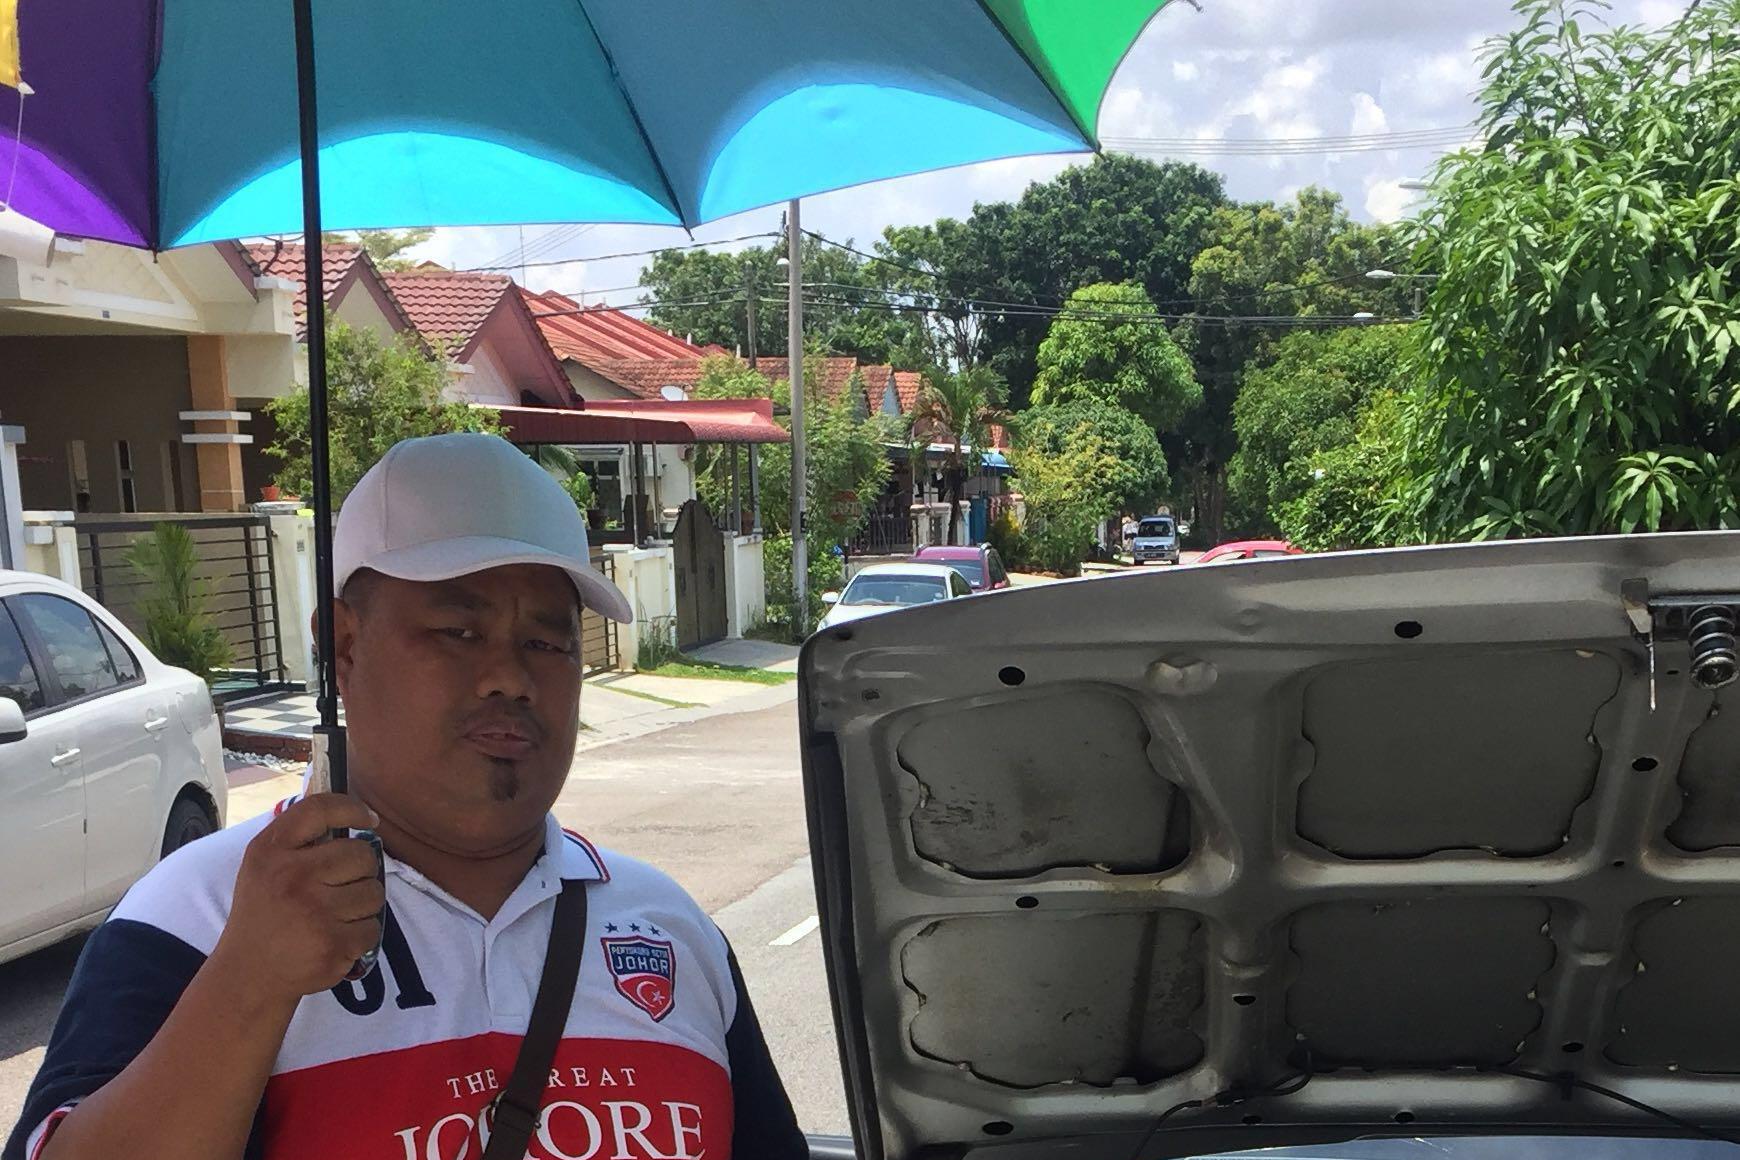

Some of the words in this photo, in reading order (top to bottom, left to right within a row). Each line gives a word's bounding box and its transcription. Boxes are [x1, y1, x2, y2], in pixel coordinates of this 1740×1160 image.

[615, 956, 669, 974] JOHOR
[447, 1068, 497, 1099] THE
[549, 1067, 636, 1088] REAT
